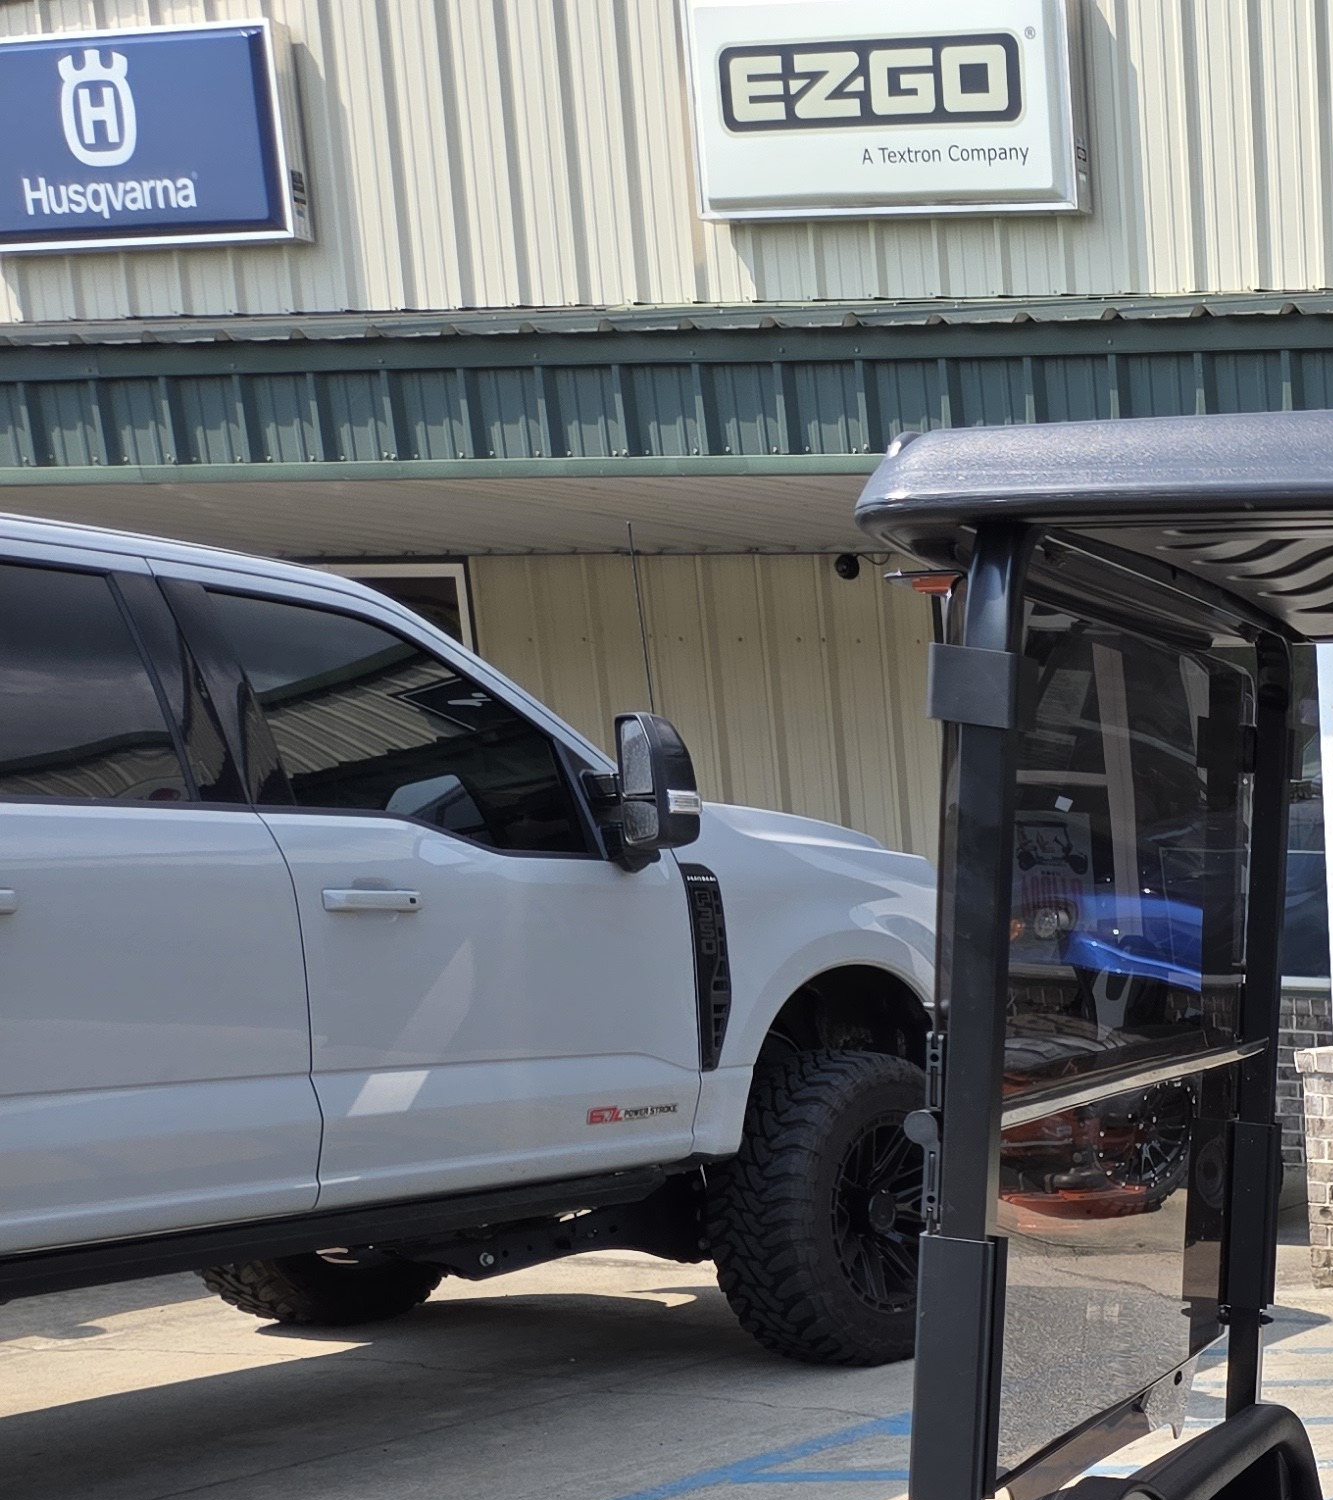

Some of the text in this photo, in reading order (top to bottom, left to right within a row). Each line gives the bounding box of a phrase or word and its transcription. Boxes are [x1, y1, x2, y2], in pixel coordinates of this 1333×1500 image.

[728, 44, 1010, 122] EZGO
[862, 144, 1029, 166] A Textron Company
[22, 176, 198, 219] Husqvarna
[624, 1106, 649, 1118] POWER
[649, 1104, 678, 1115] STROKE
